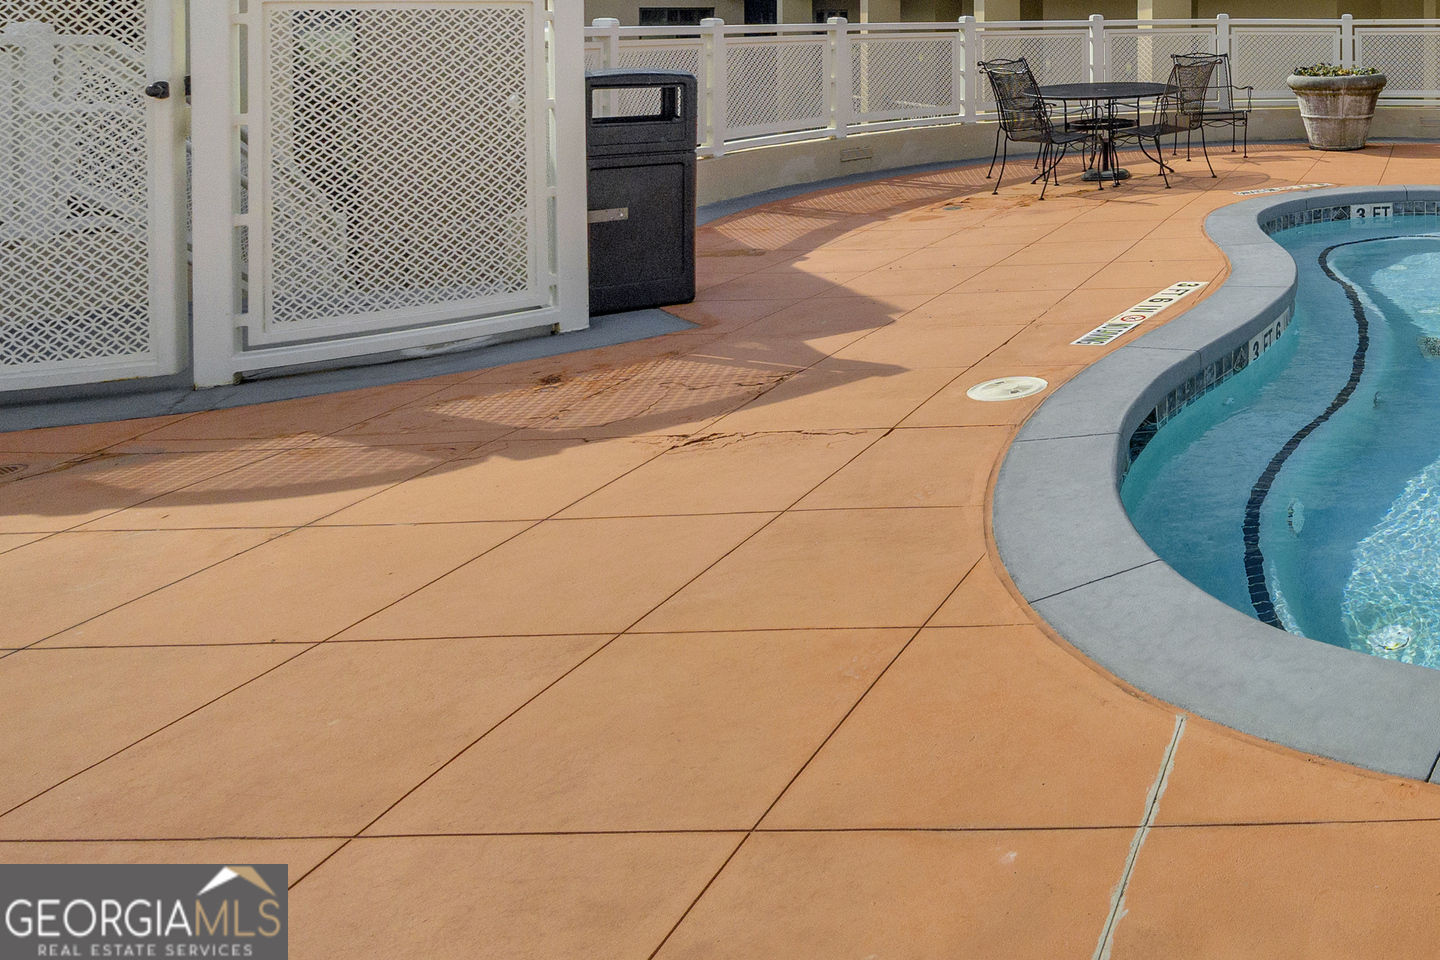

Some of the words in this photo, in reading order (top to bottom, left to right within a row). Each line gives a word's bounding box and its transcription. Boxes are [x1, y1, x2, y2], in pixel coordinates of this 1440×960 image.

[1356, 207, 1366, 218] 3
[1373, 205, 1391, 218] FT
[1253, 340, 1260, 361] 3
[1263, 327, 1273, 353] FT
[1275, 321, 1281, 340] 6
